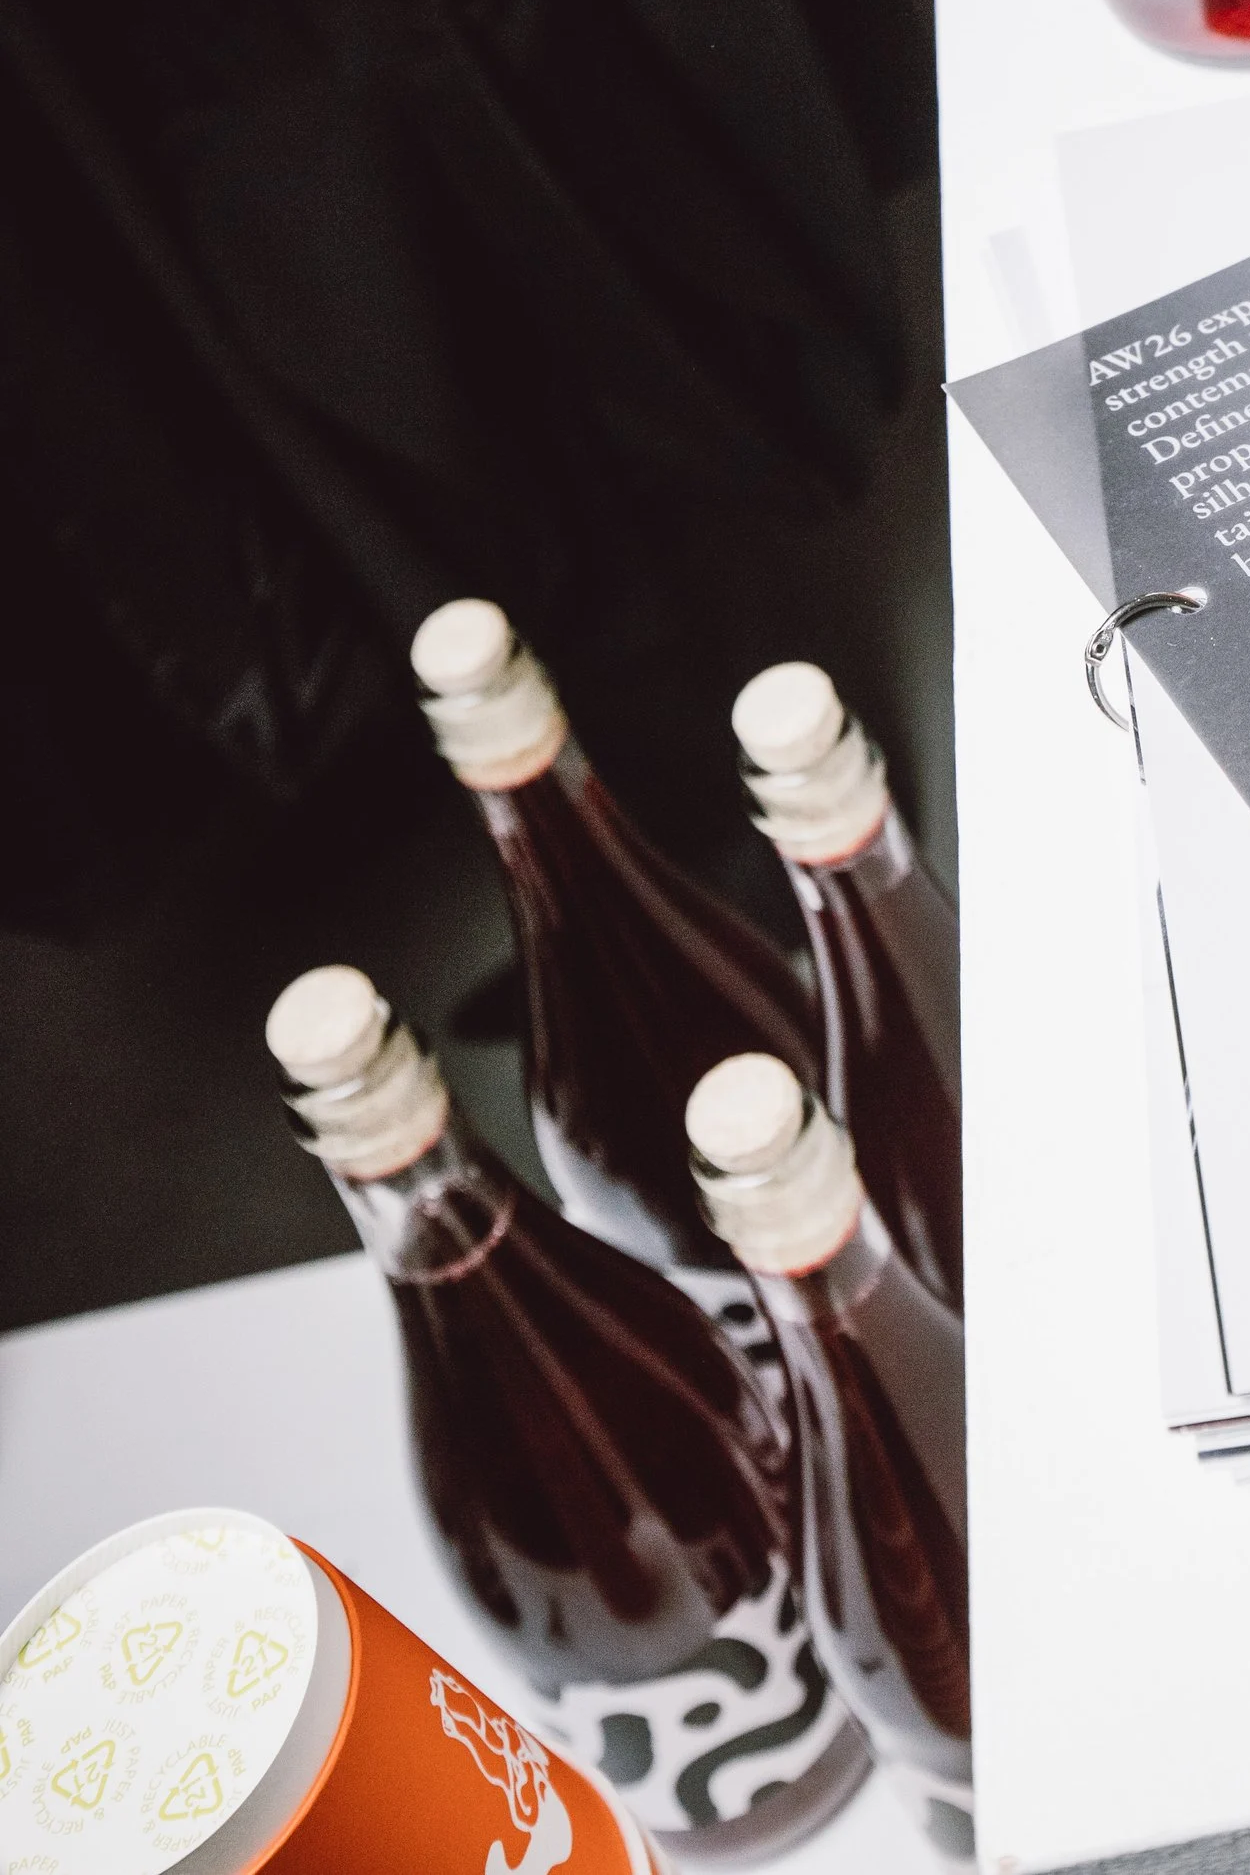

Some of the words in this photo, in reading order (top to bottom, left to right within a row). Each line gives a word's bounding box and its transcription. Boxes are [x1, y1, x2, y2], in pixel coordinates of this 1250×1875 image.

[1090, 324, 1193, 386] AW26
[1105, 338, 1247, 412] strength
[42, 1655, 74, 1684] PAP
[100, 1663, 117, 1691] PAP
[251, 1682, 283, 1712] PAP
[60, 1726, 93, 1754] PAP
